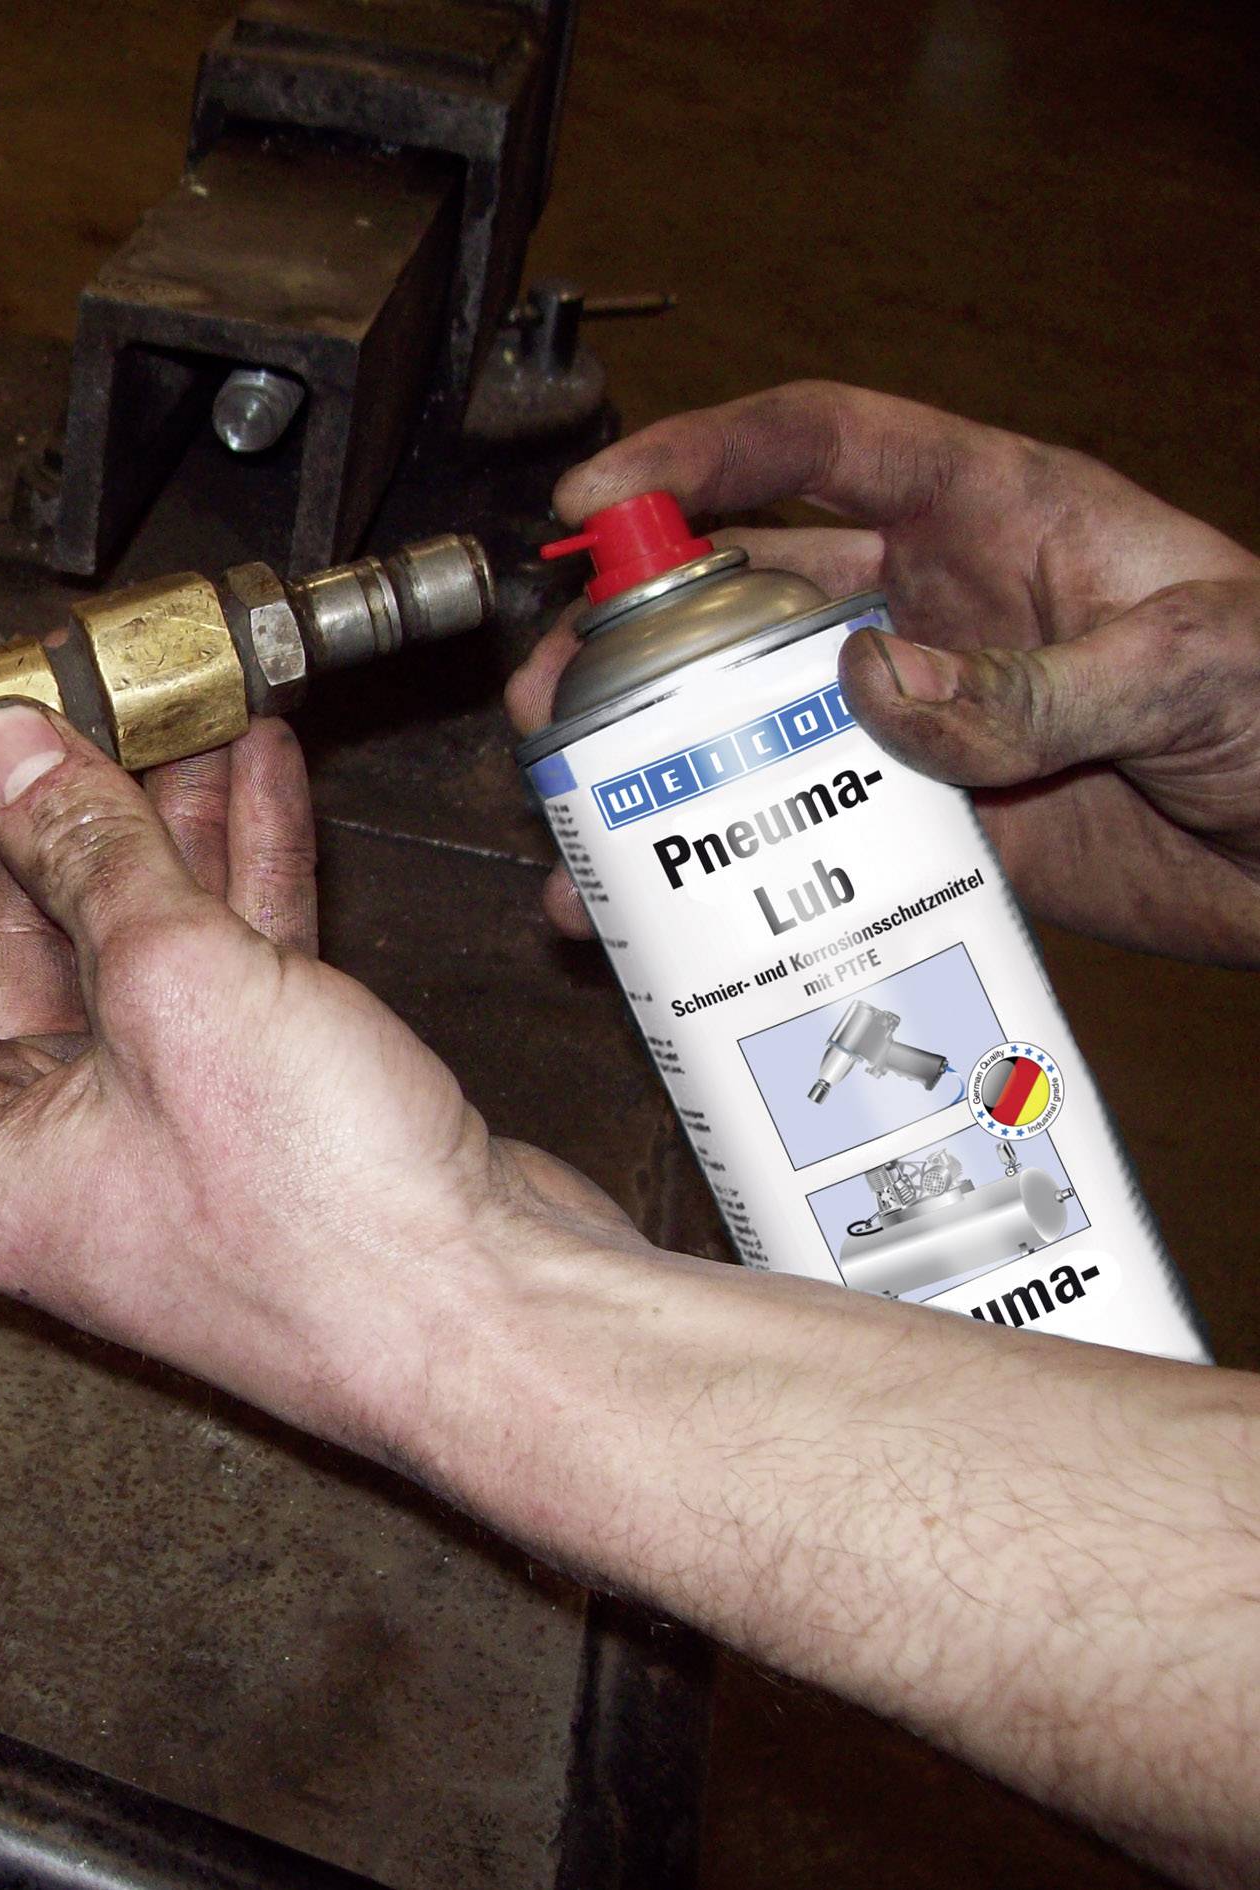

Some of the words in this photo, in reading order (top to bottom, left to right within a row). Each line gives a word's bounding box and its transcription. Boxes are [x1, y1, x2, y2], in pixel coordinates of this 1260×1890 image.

[652, 769, 883, 890] Pneuma-
[753, 859, 856, 937] Lub
[670, 980, 751, 1018] Schmier-
[754, 959, 789, 987] und
[789, 868, 986, 973] Korrosionsschutzmittel
[803, 972, 835, 997] mit
[834, 948, 883, 984] PTFE
[972, 1071, 984, 1105] German
[979, 1050, 1005, 1070] Quality
[1027, 1103, 1058, 1134] Industrial
[1051, 1077, 1062, 1103] grade
